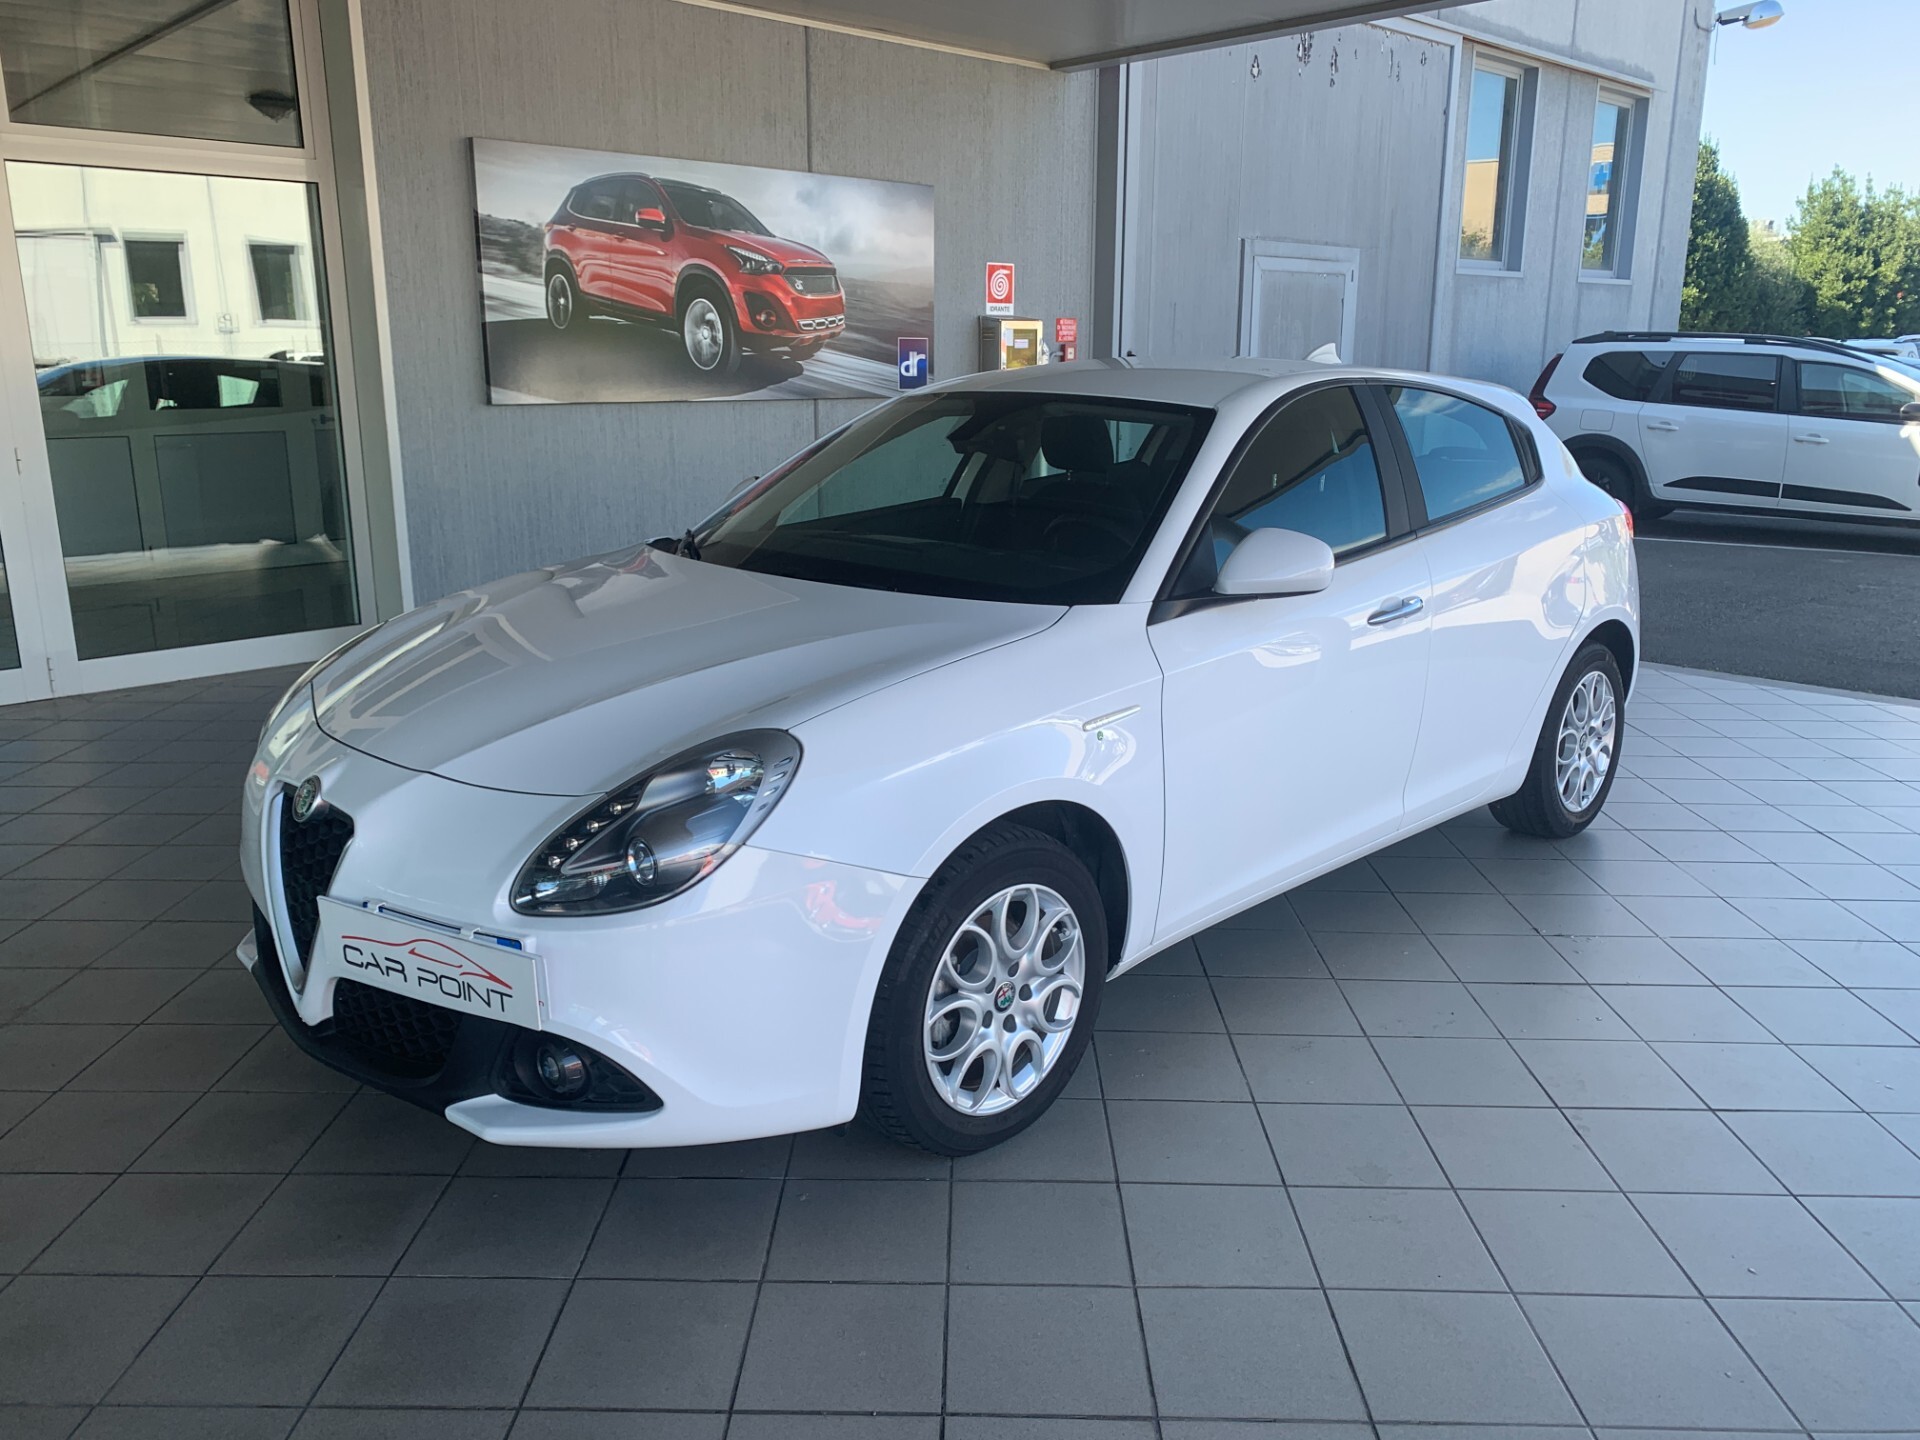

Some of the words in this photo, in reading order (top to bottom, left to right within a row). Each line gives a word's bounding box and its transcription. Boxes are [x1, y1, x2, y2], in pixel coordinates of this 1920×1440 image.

[989, 305, 1010, 313] IDRANTE
[900, 351, 926, 377] dr
[343, 944, 408, 983] CAR
[416, 967, 513, 1013] POINT
